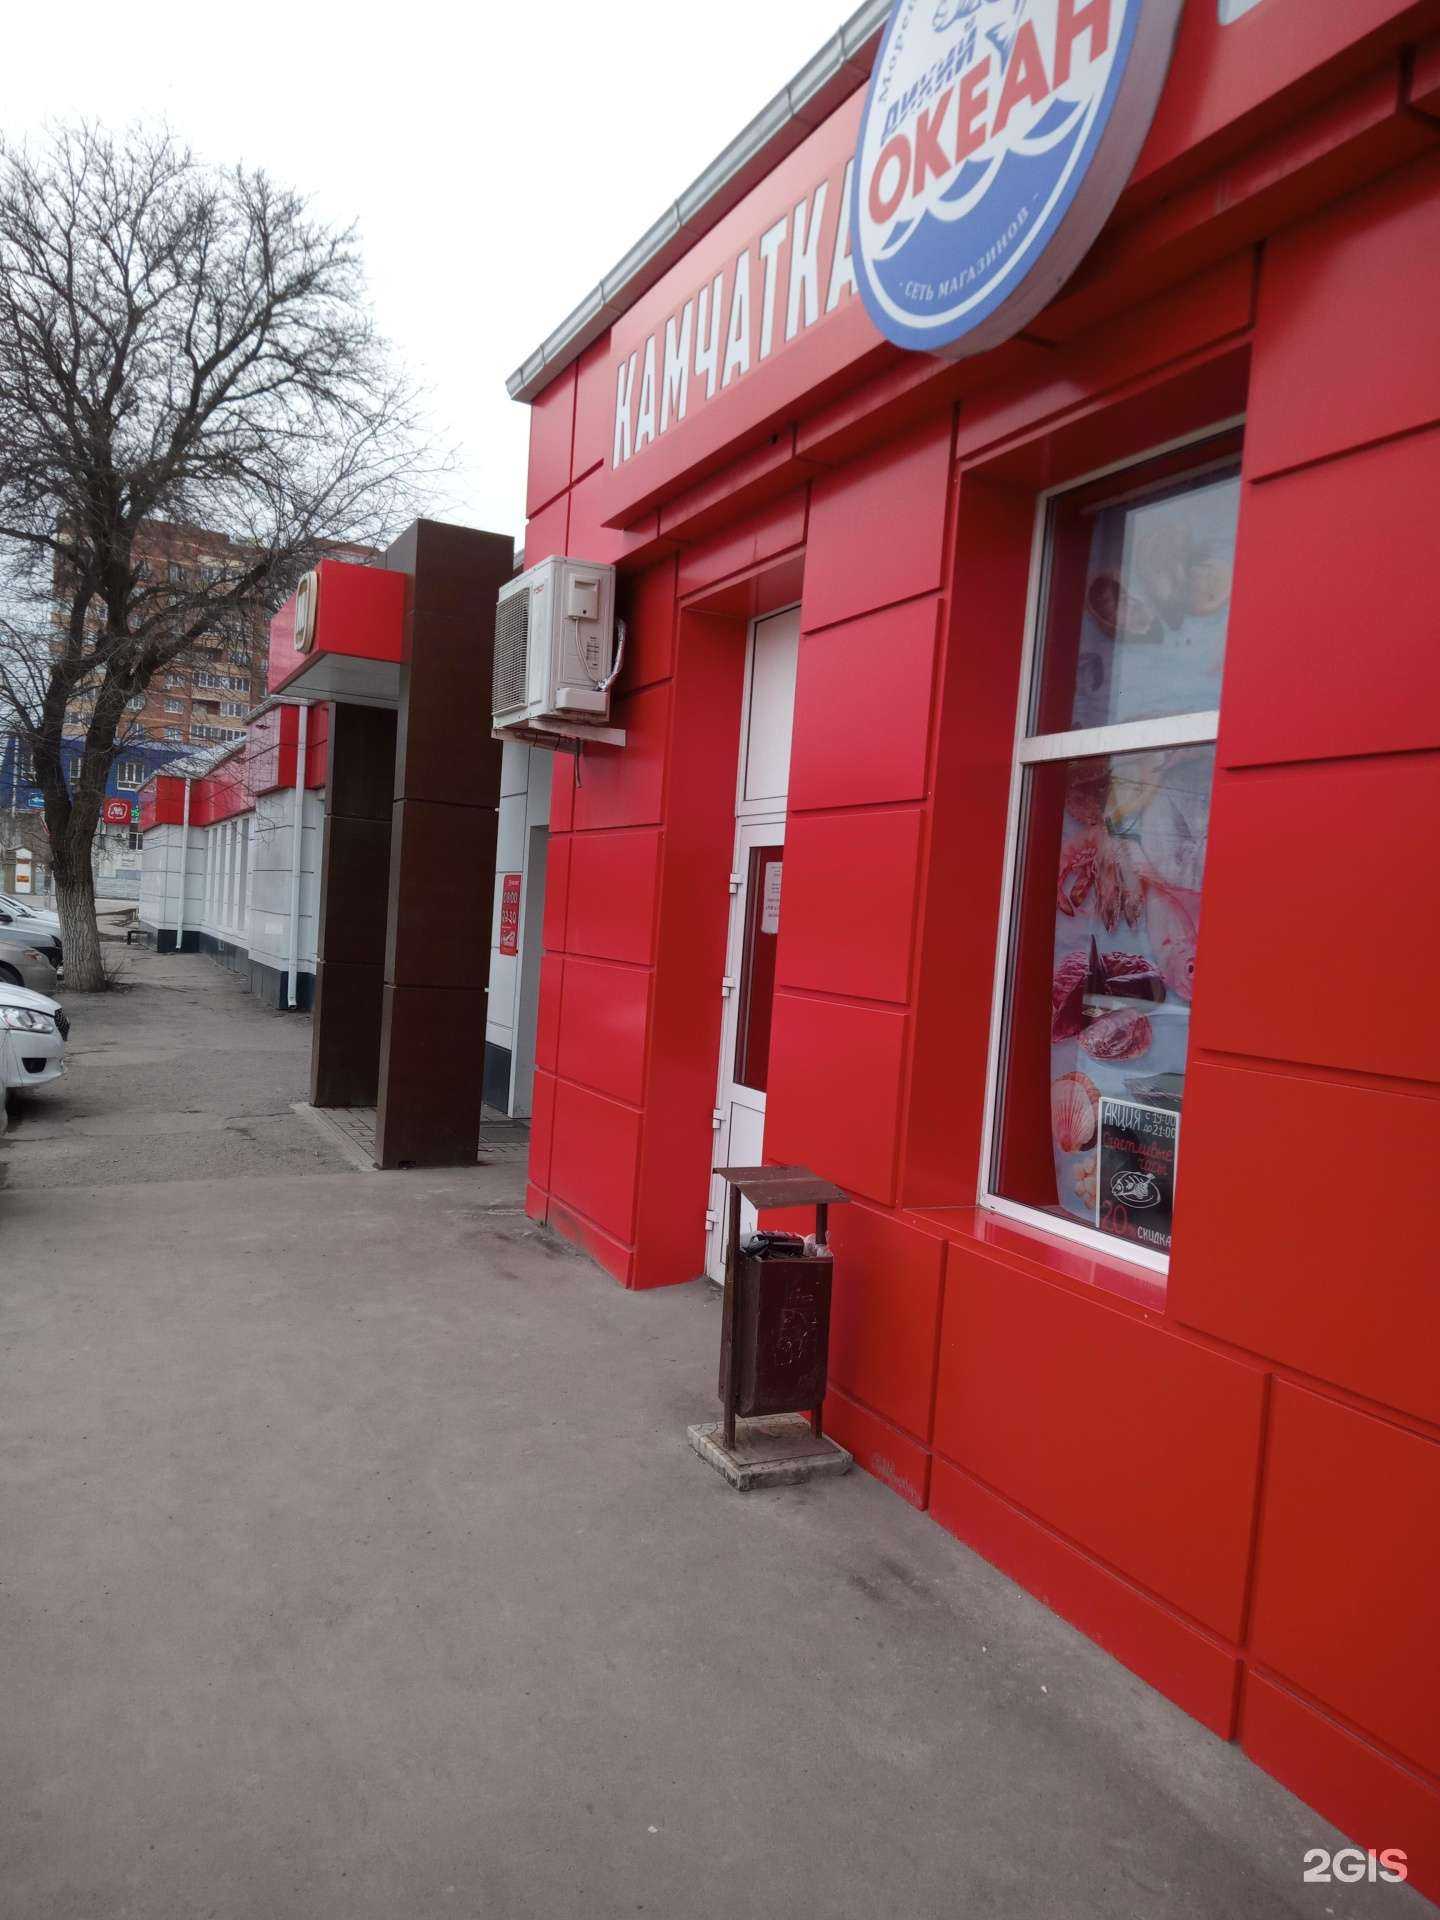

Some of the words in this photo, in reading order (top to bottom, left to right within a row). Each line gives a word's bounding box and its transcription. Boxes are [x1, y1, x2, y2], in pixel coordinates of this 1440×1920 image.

[868, 0, 1112, 225] ОКЕАН
[611, 156, 858, 471] КАМЧАТКА
[904, 280, 934, 301] СЕТЬ
[938, 206, 1029, 298] МАГАЗИНОВ
[1104, 1102, 1142, 1131] АКЦИЯ
